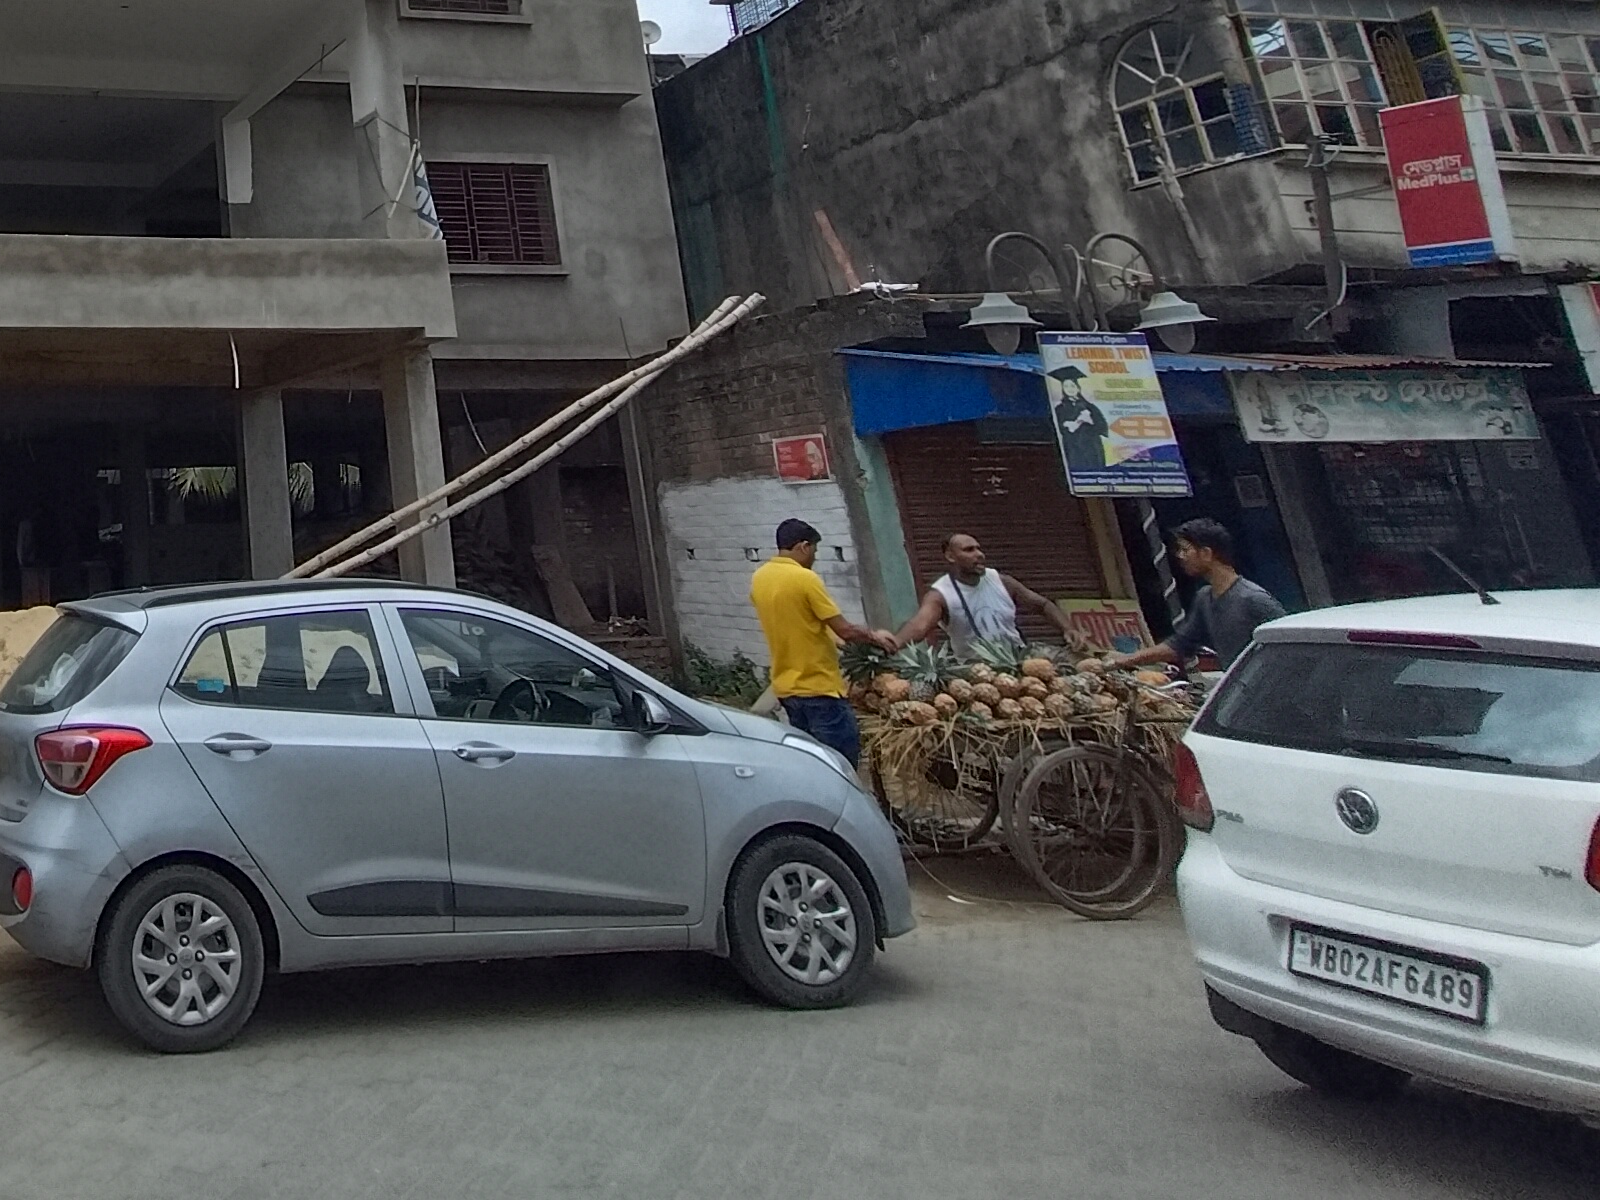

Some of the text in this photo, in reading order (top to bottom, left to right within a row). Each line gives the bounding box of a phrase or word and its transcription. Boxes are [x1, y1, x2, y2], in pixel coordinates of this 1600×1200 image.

[1397, 174, 1460, 191] MedPlus
[1057, 335, 1128, 345] Admission Open
[1065, 347, 1148, 360] LEARNING TWIST
[1088, 361, 1130, 374] SCHOOL
[1310, 940, 1474, 1008] WB02AF6489
